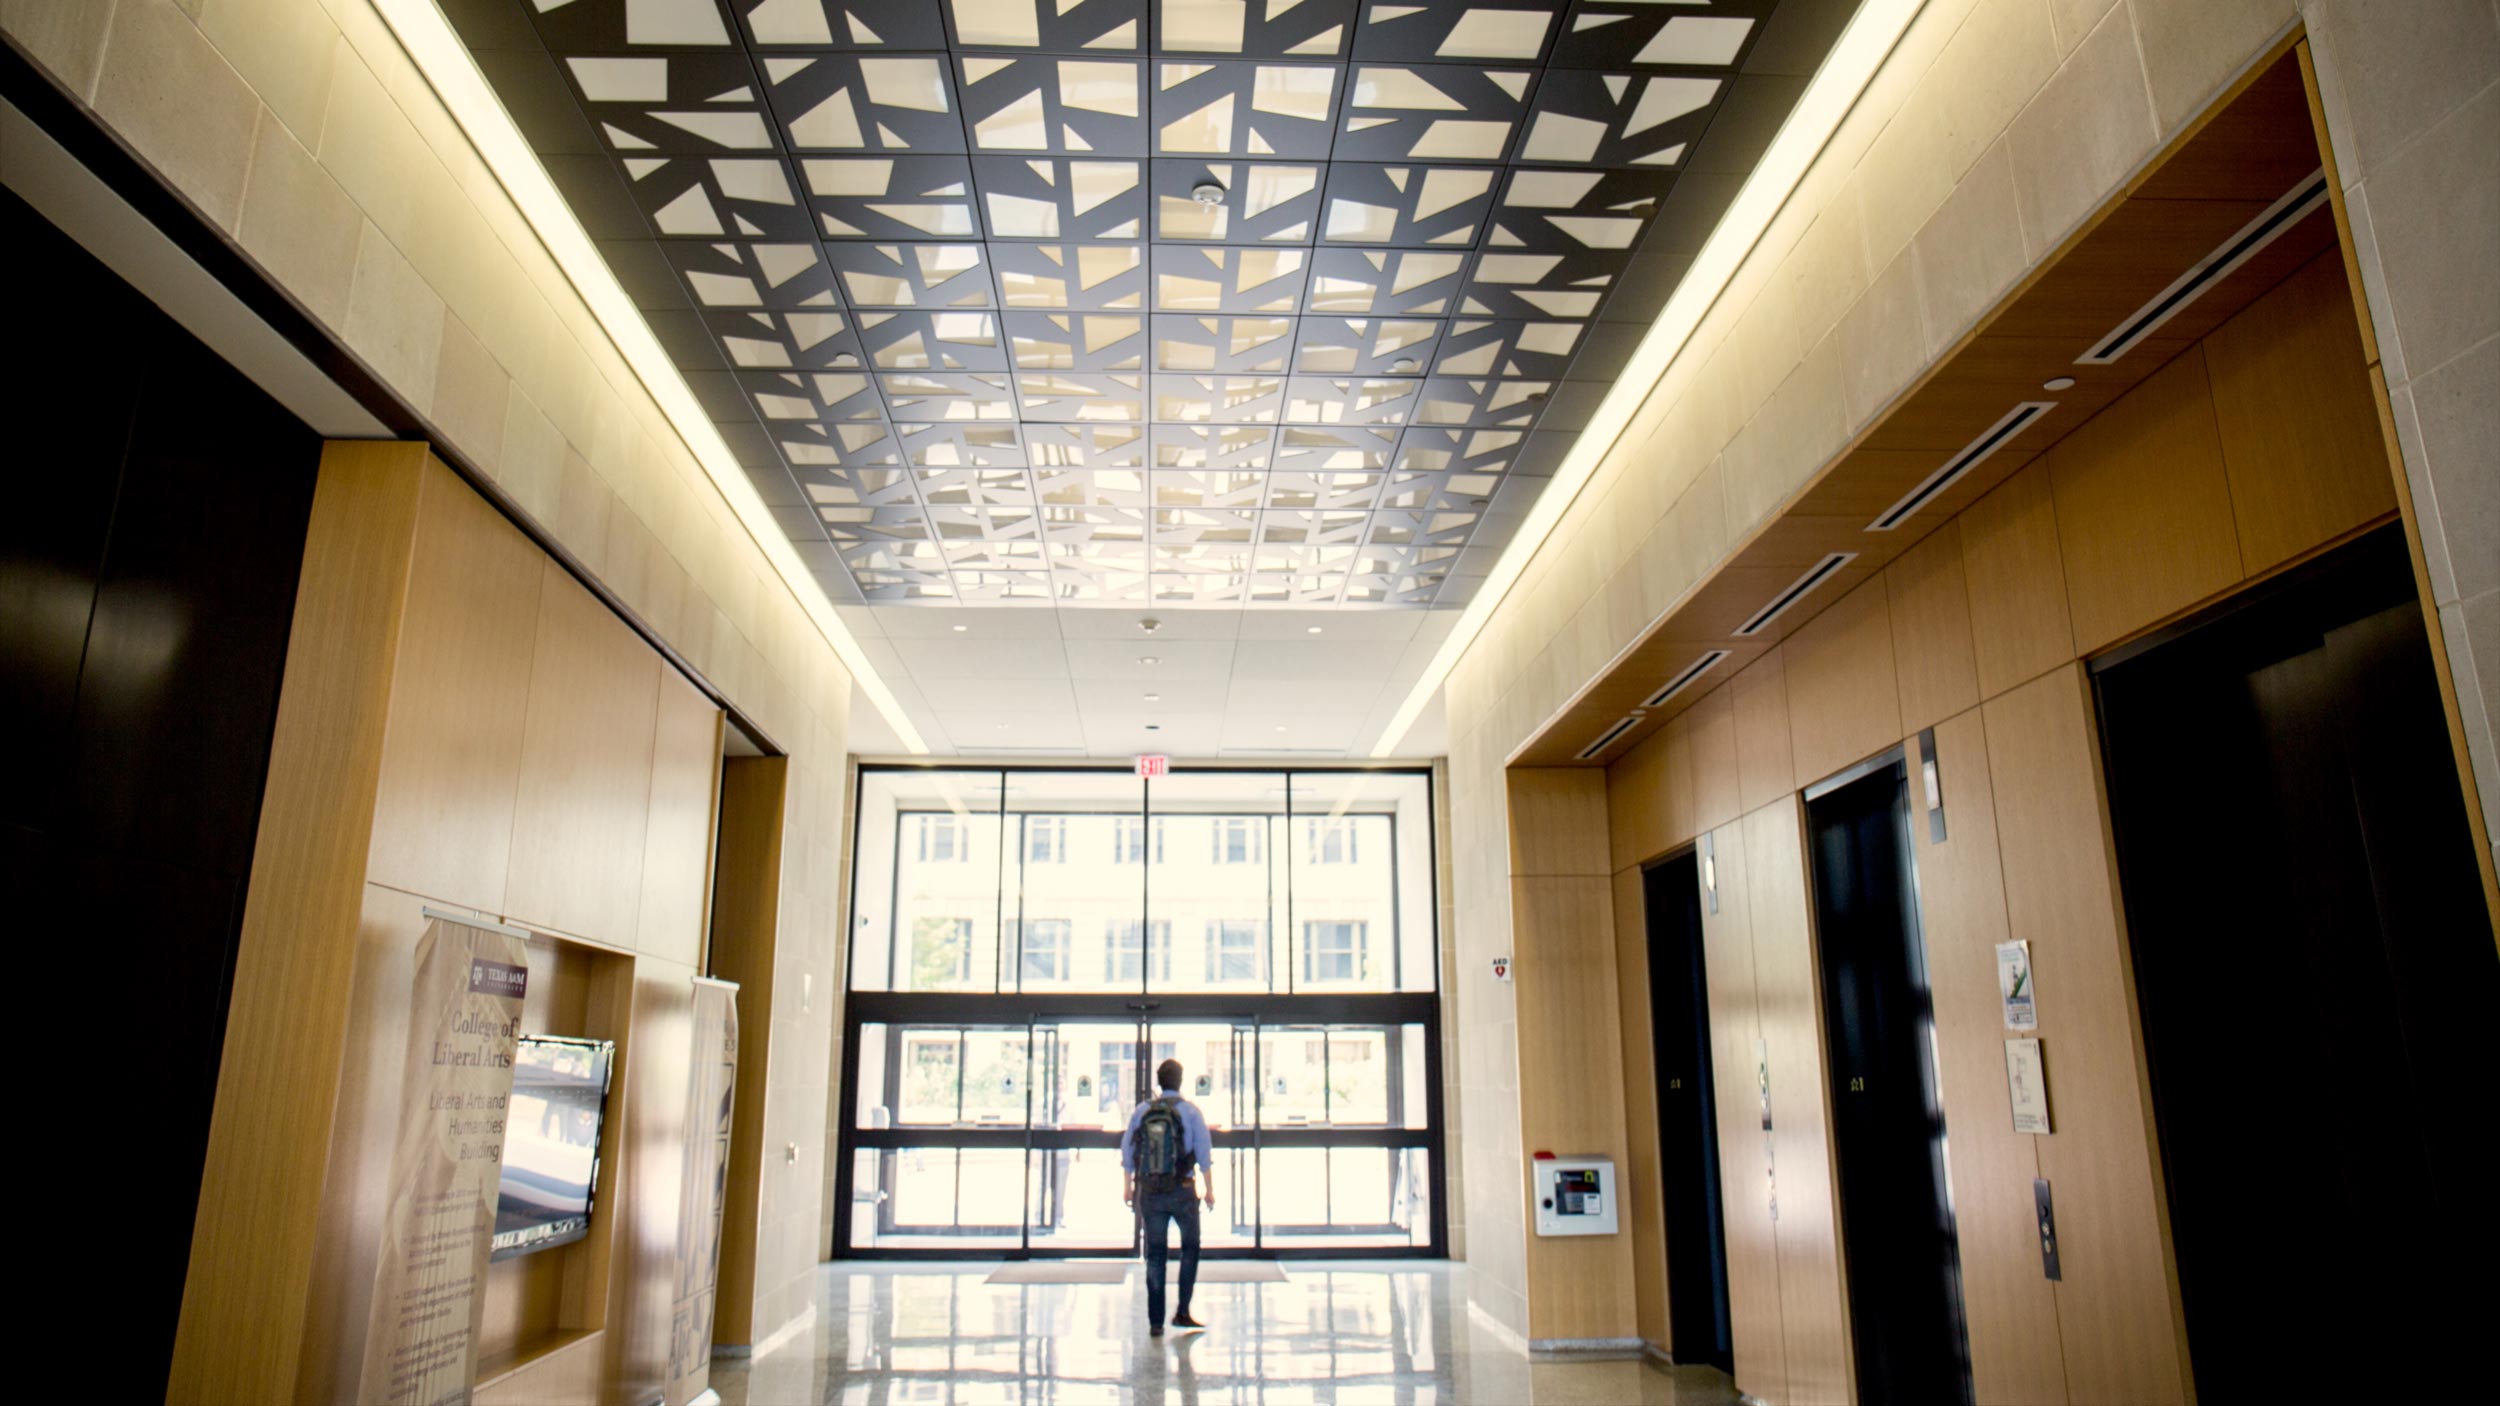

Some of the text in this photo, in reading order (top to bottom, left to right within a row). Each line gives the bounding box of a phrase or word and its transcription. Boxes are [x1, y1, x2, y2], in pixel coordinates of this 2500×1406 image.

[1141, 757, 1165, 775] EXIT
[452, 1010, 519, 1043] College of
[432, 1041, 511, 1069] Liberal Arts
[430, 1090, 507, 1111] Liberal Arts and
[448, 1116, 503, 1136] Humanities
[460, 1140, 500, 1163] Building
